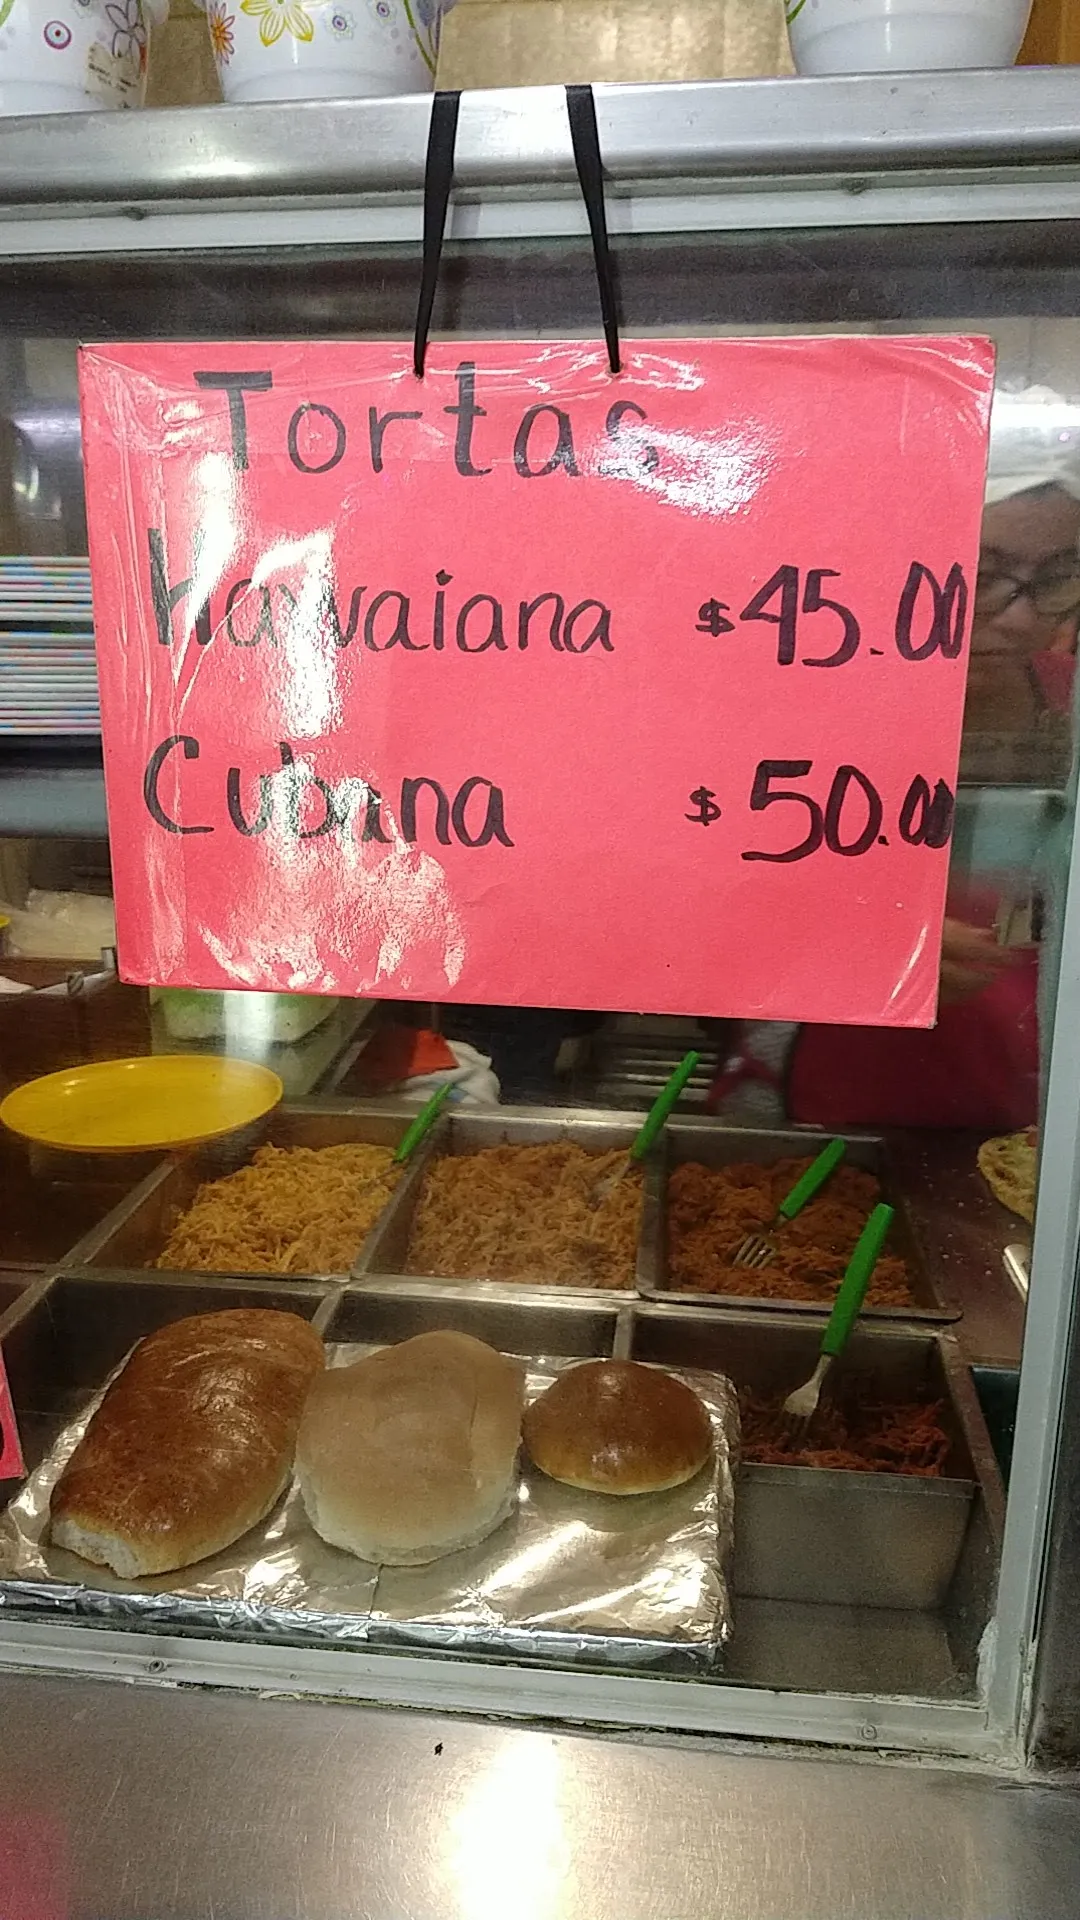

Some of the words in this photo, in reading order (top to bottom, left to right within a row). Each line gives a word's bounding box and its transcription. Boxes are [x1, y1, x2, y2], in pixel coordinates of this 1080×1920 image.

[193, 361, 659, 478] Tortas
[695, 561, 968, 668] $45.00
[143, 734, 515, 848] Cubana
